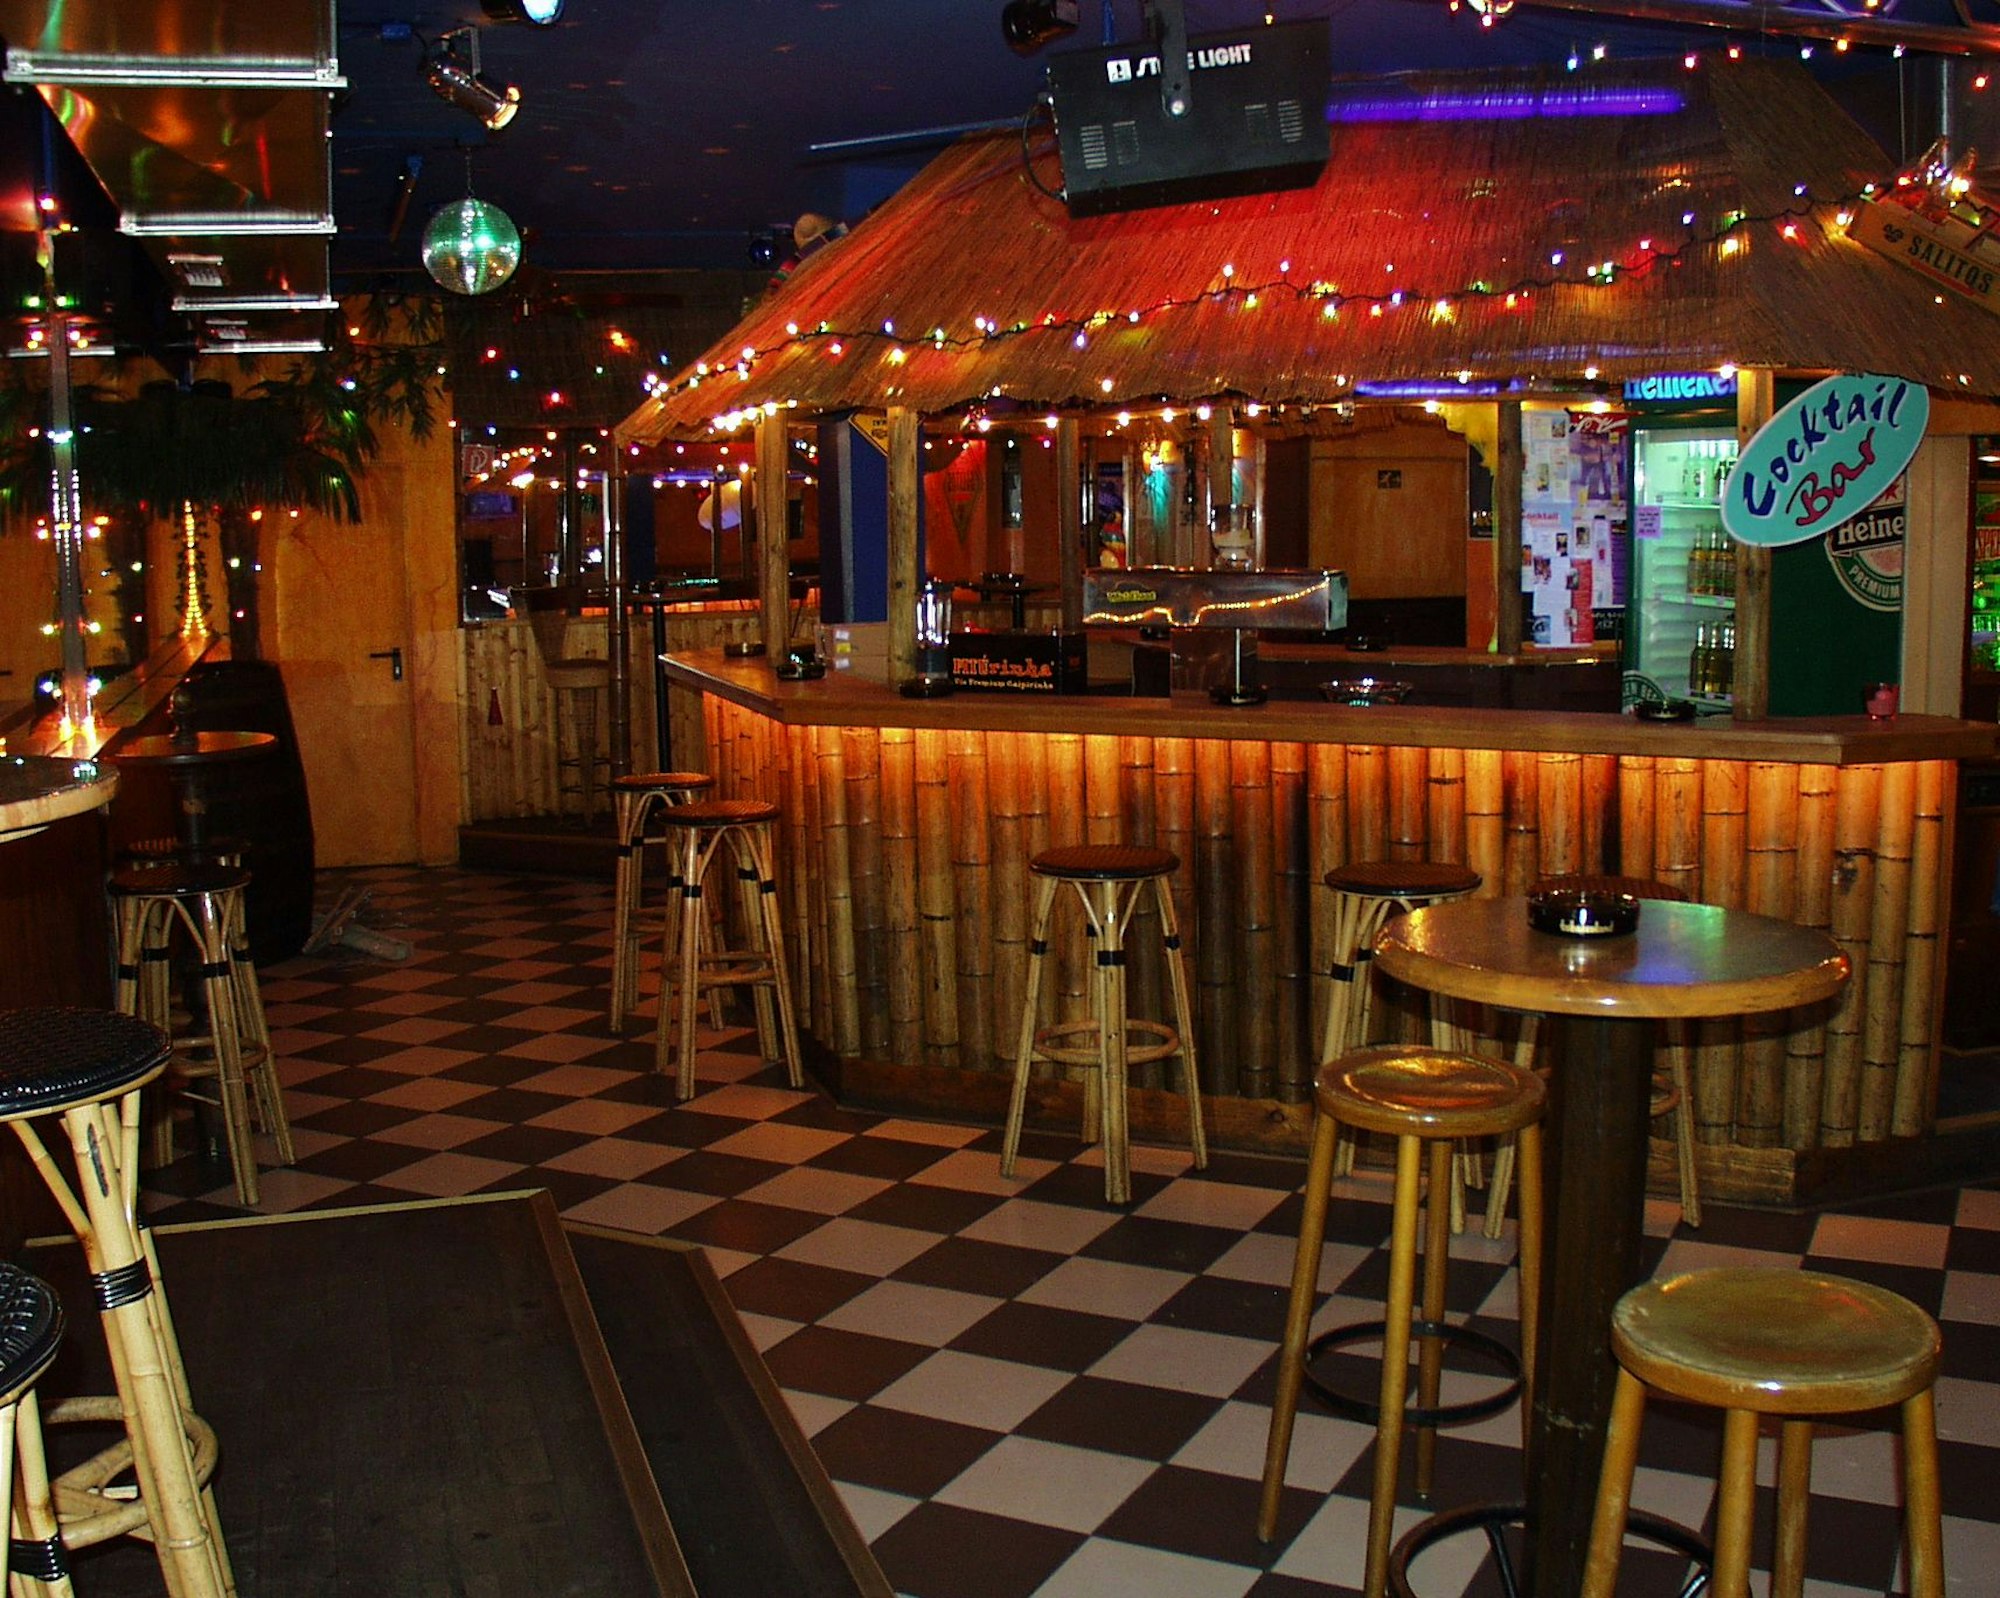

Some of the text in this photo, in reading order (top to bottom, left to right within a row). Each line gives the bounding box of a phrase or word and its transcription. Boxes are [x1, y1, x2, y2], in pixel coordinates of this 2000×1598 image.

[1135, 43, 1251, 78] STE LIGHT
[1908, 235, 1993, 293] SALITOS
[1743, 382, 1906, 517] Cocktail
[1785, 426, 1876, 527] Bar
[1848, 564, 1900, 599] PREMIUM
